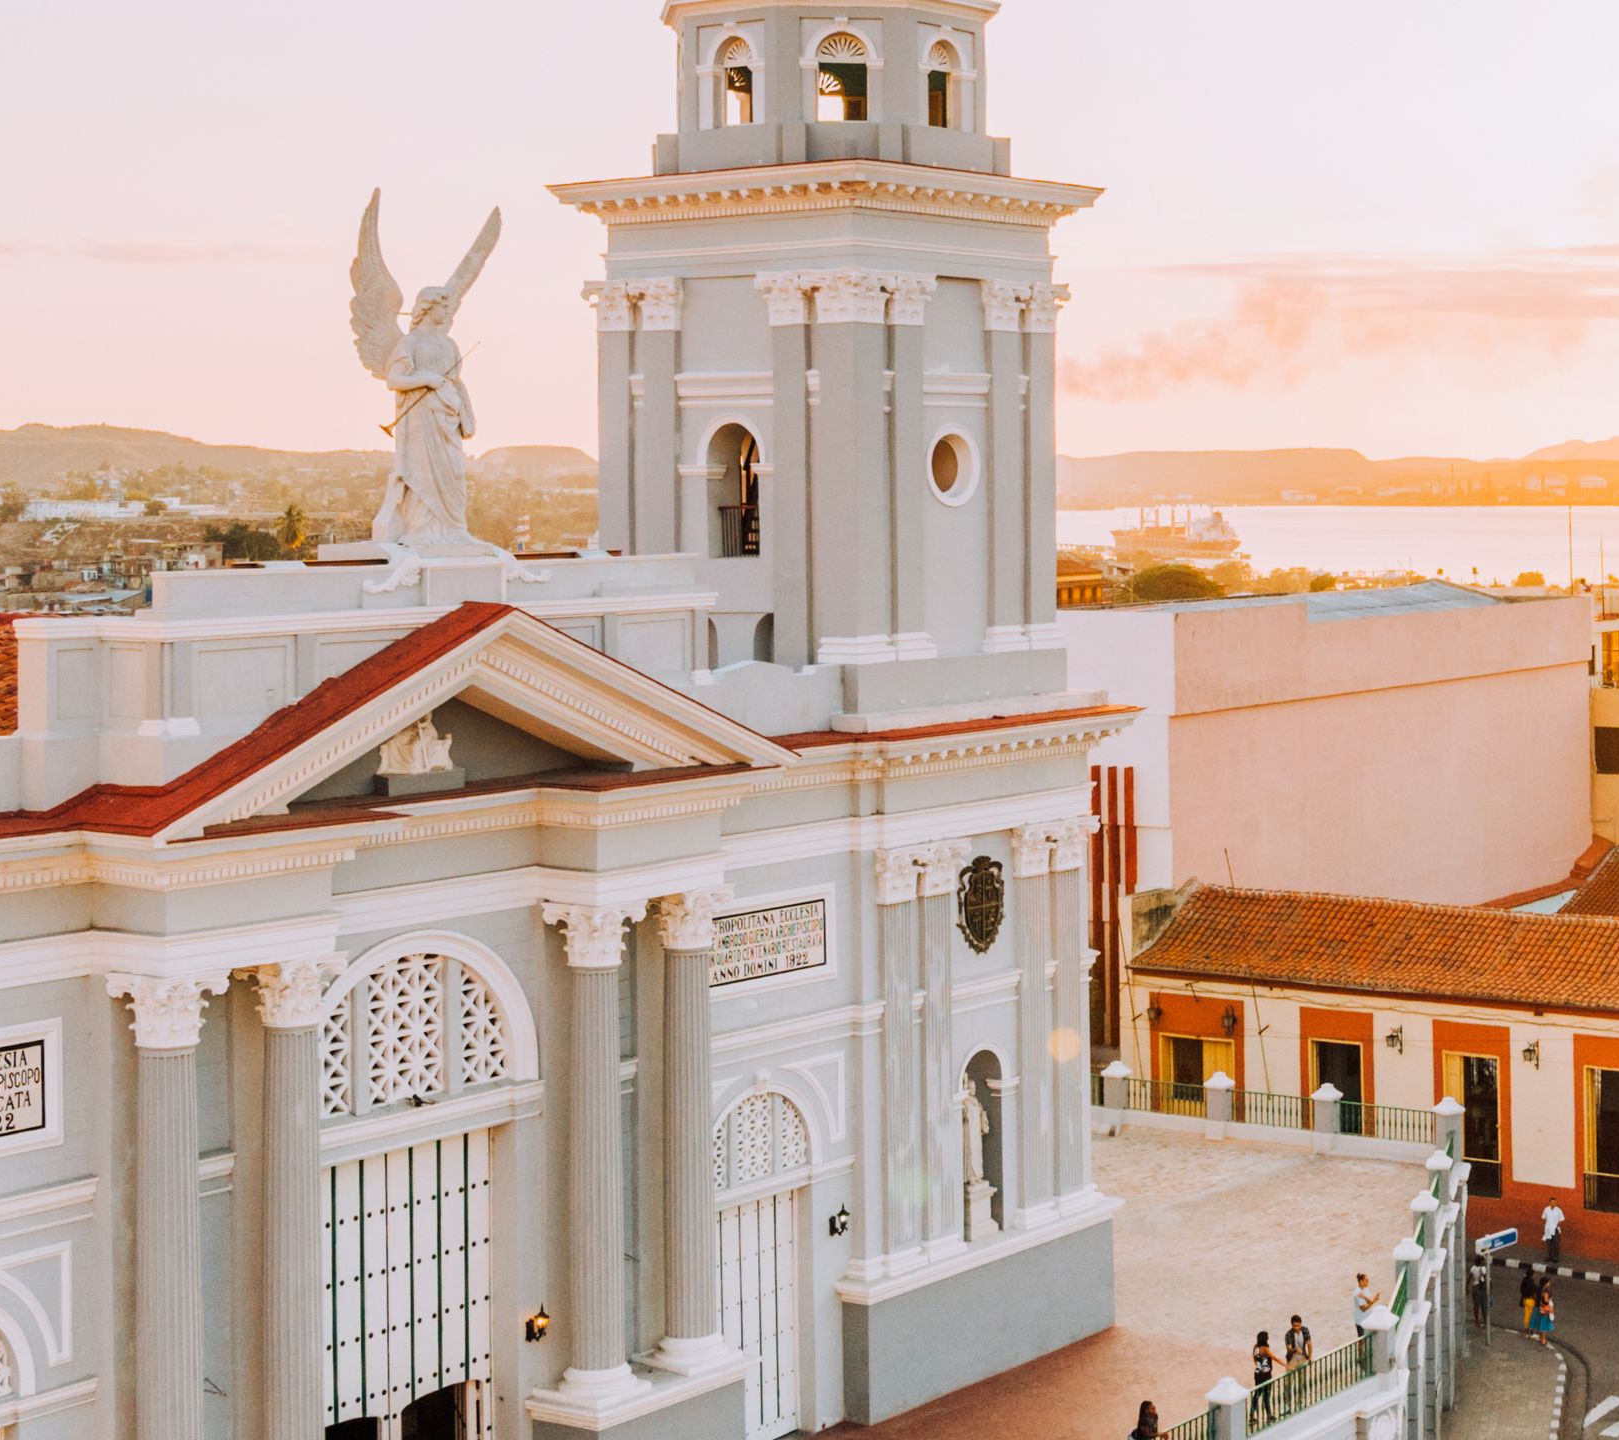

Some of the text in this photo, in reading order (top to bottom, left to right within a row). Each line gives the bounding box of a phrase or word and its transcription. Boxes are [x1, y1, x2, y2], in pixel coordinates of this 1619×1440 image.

[712, 904, 819, 935] TROPOLITANA ECCLESIA
[712, 952, 809, 983] ANNO DOMINI 1922
